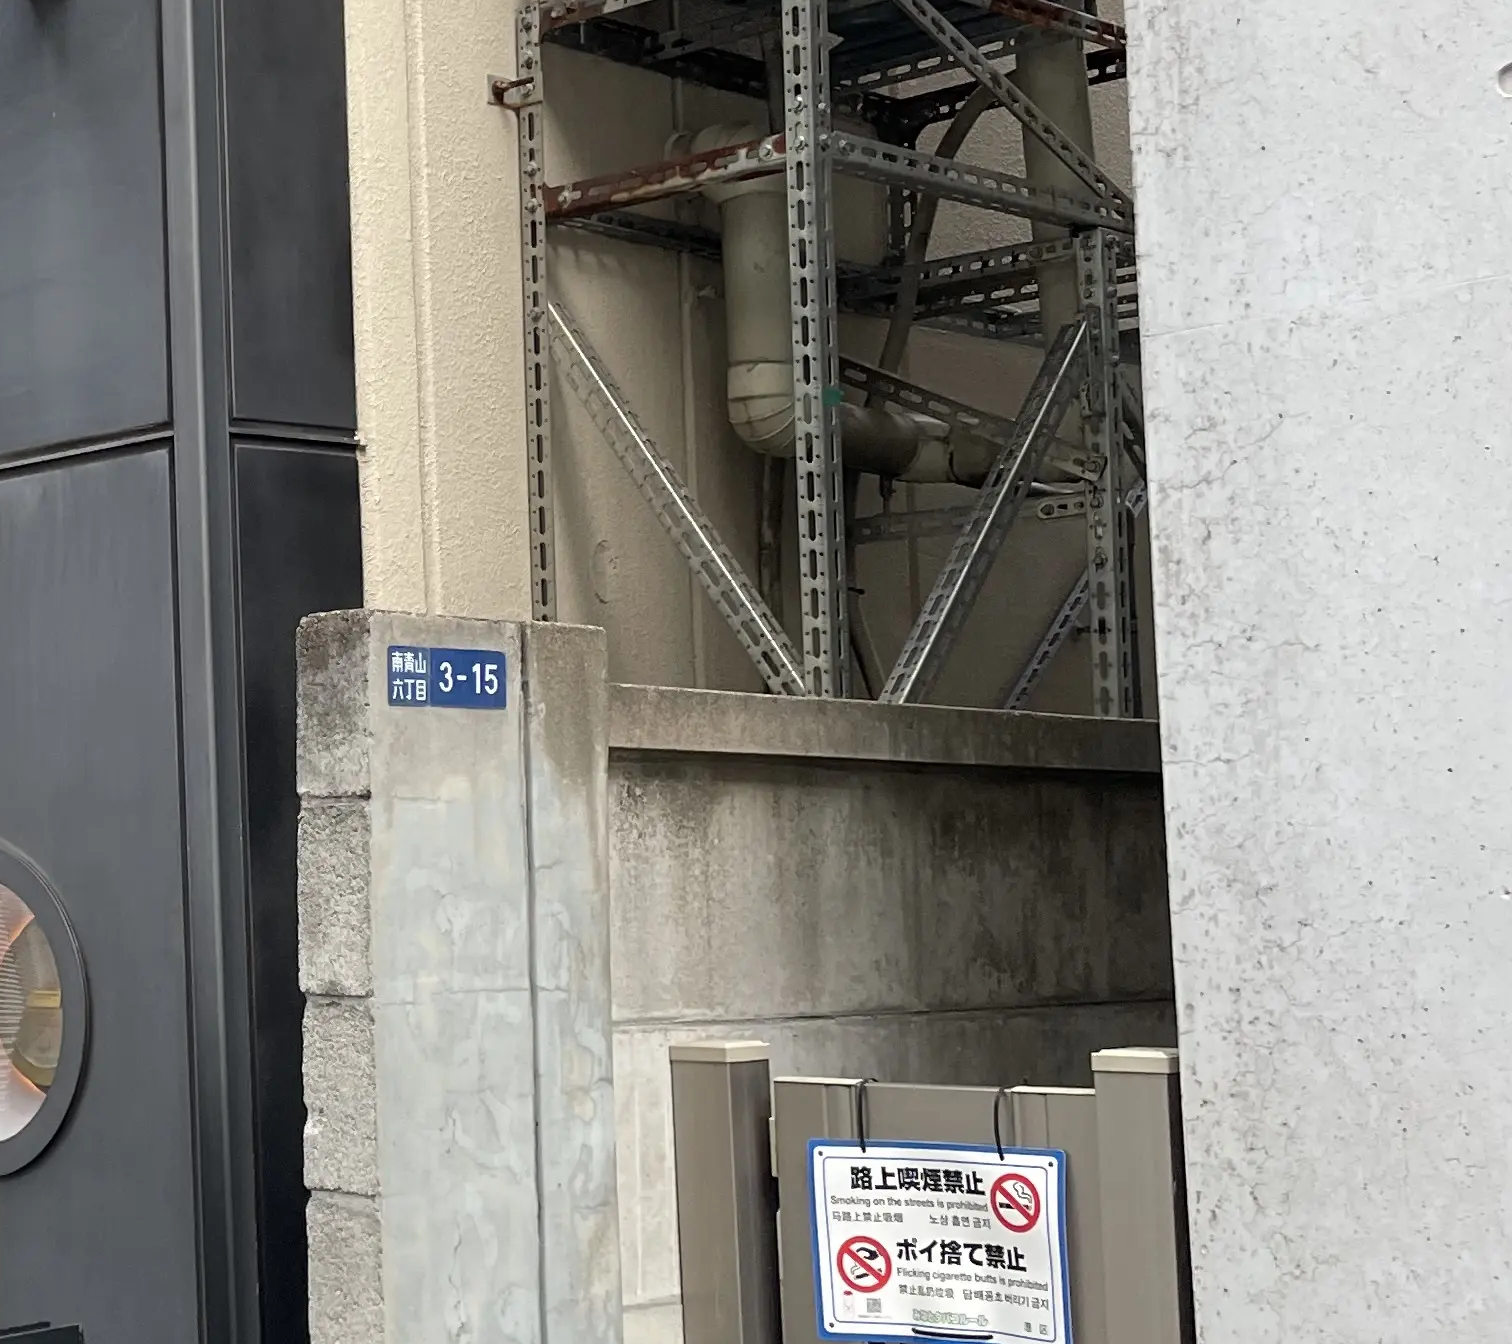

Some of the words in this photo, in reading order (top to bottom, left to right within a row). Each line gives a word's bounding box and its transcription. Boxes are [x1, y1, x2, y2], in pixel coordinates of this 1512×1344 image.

[390, 650, 427, 675] 南青山
[438, 660, 499, 695] 3-15
[391, 678, 427, 701] 六丁目
[850, 1166, 986, 1196] 路上喫煙禁止
[830, 1196, 871, 1207] Smoking
[873, 1198, 885, 1206] on
[887, 1197, 902, 1206] the
[904, 1198, 935, 1208] streets
[946, 1201, 989, 1213] prohibited
[896, 1238, 1027, 1272] ポイ捨て禁止
[932, 1271, 972, 1283] cigarette
